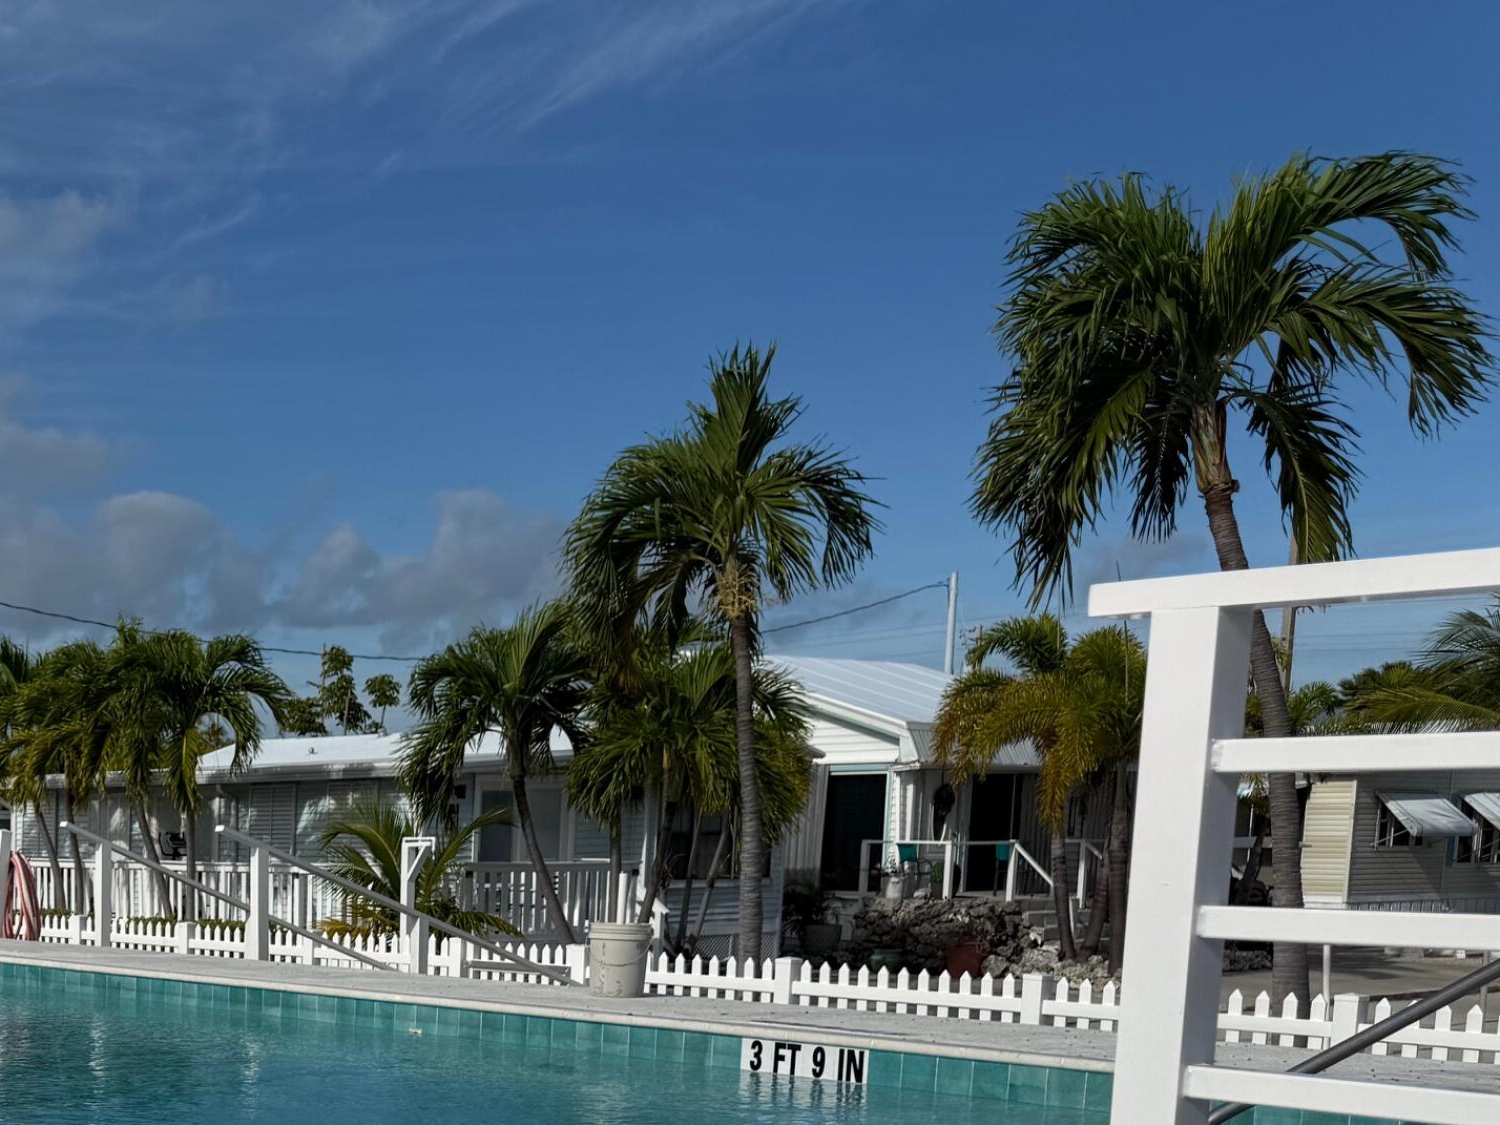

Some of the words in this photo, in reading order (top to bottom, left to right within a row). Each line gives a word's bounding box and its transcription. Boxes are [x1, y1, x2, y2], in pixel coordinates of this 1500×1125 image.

[750, 1040, 763, 1072] 3
[772, 1042, 802, 1076] FT
[812, 1046, 826, 1079] 9
[837, 1048, 866, 1084] IN
